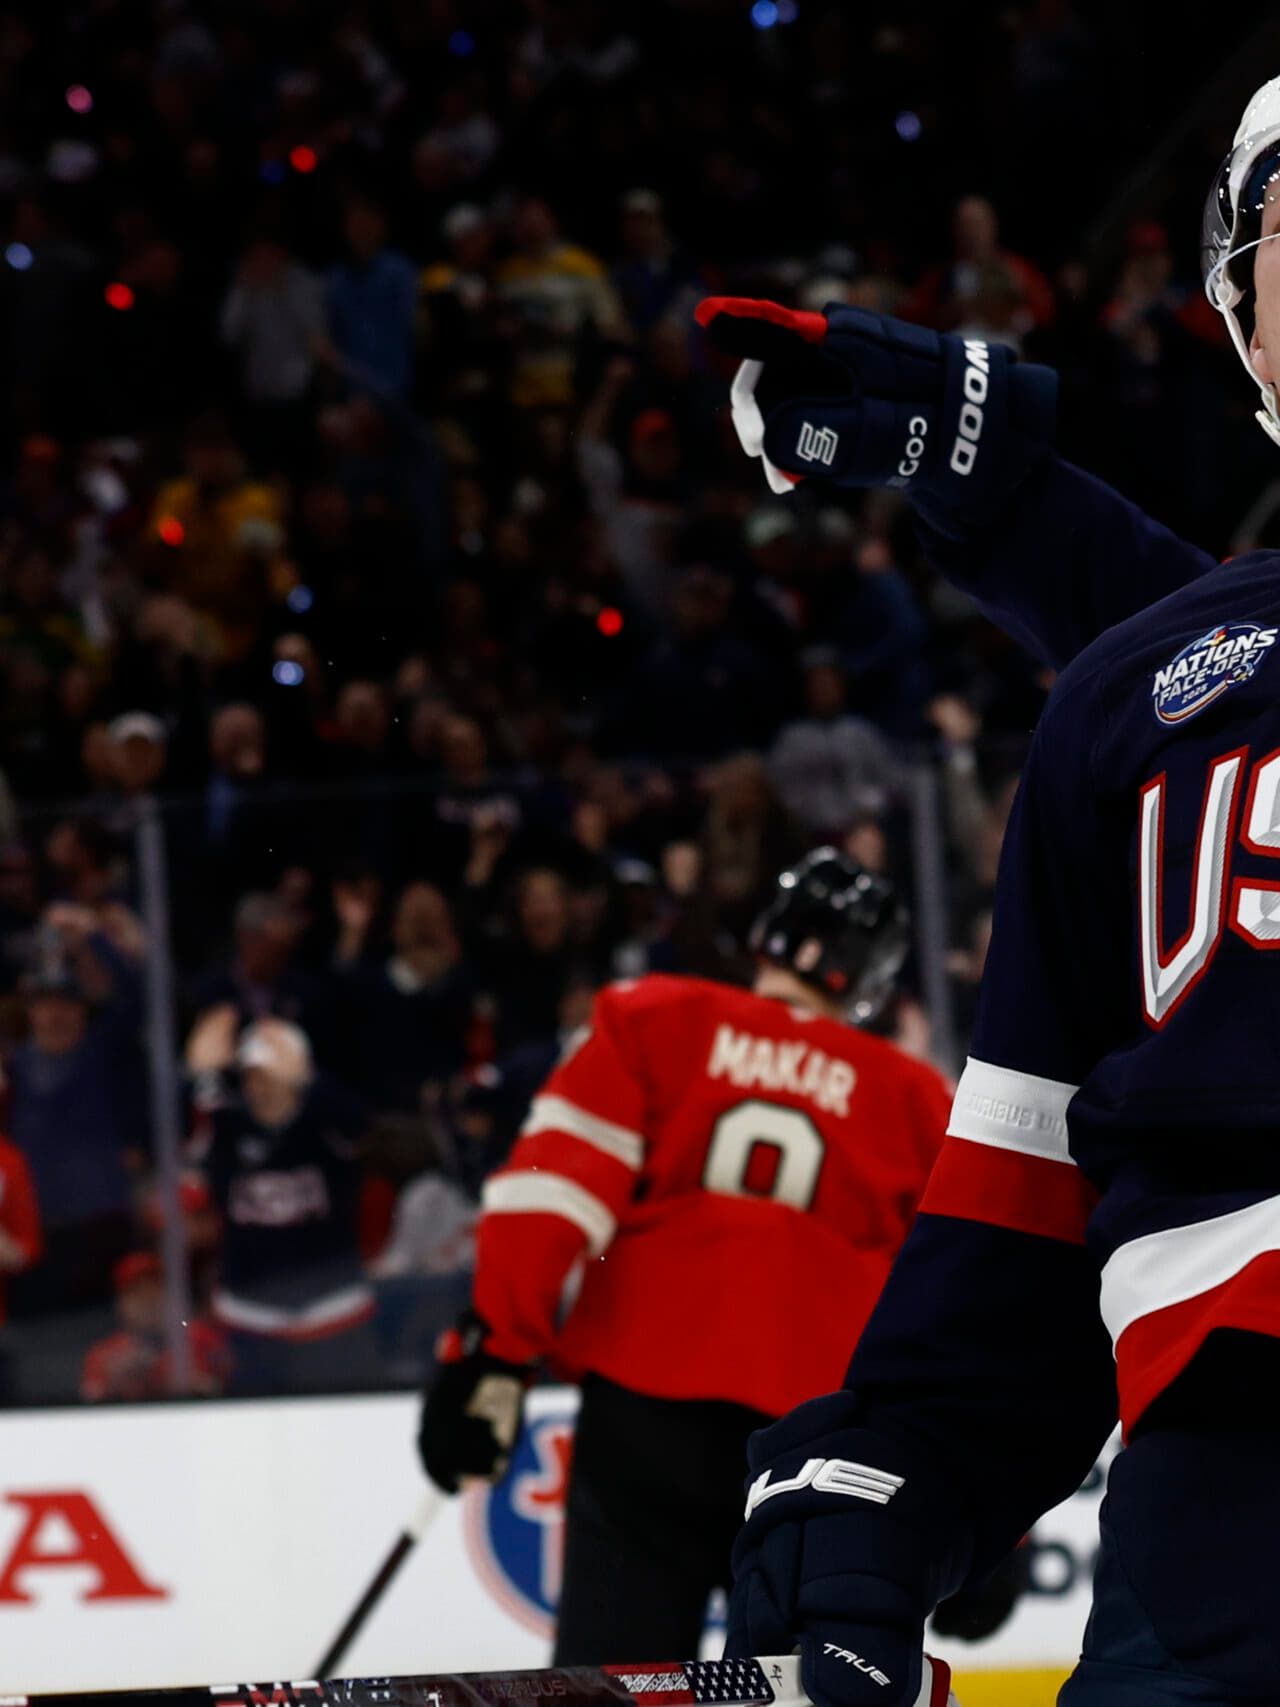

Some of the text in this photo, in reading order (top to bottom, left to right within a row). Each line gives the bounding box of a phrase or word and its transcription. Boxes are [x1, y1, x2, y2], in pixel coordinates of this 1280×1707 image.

[950, 340, 990, 476] WOOD
[1152, 628, 1279, 697] NATIONS
[1160, 649, 1258, 707] FACE-OFF
[1181, 683, 1208, 704] 2025
[706, 1024, 858, 1119] MAKAR
[823, 1642, 892, 1687] TRUE
